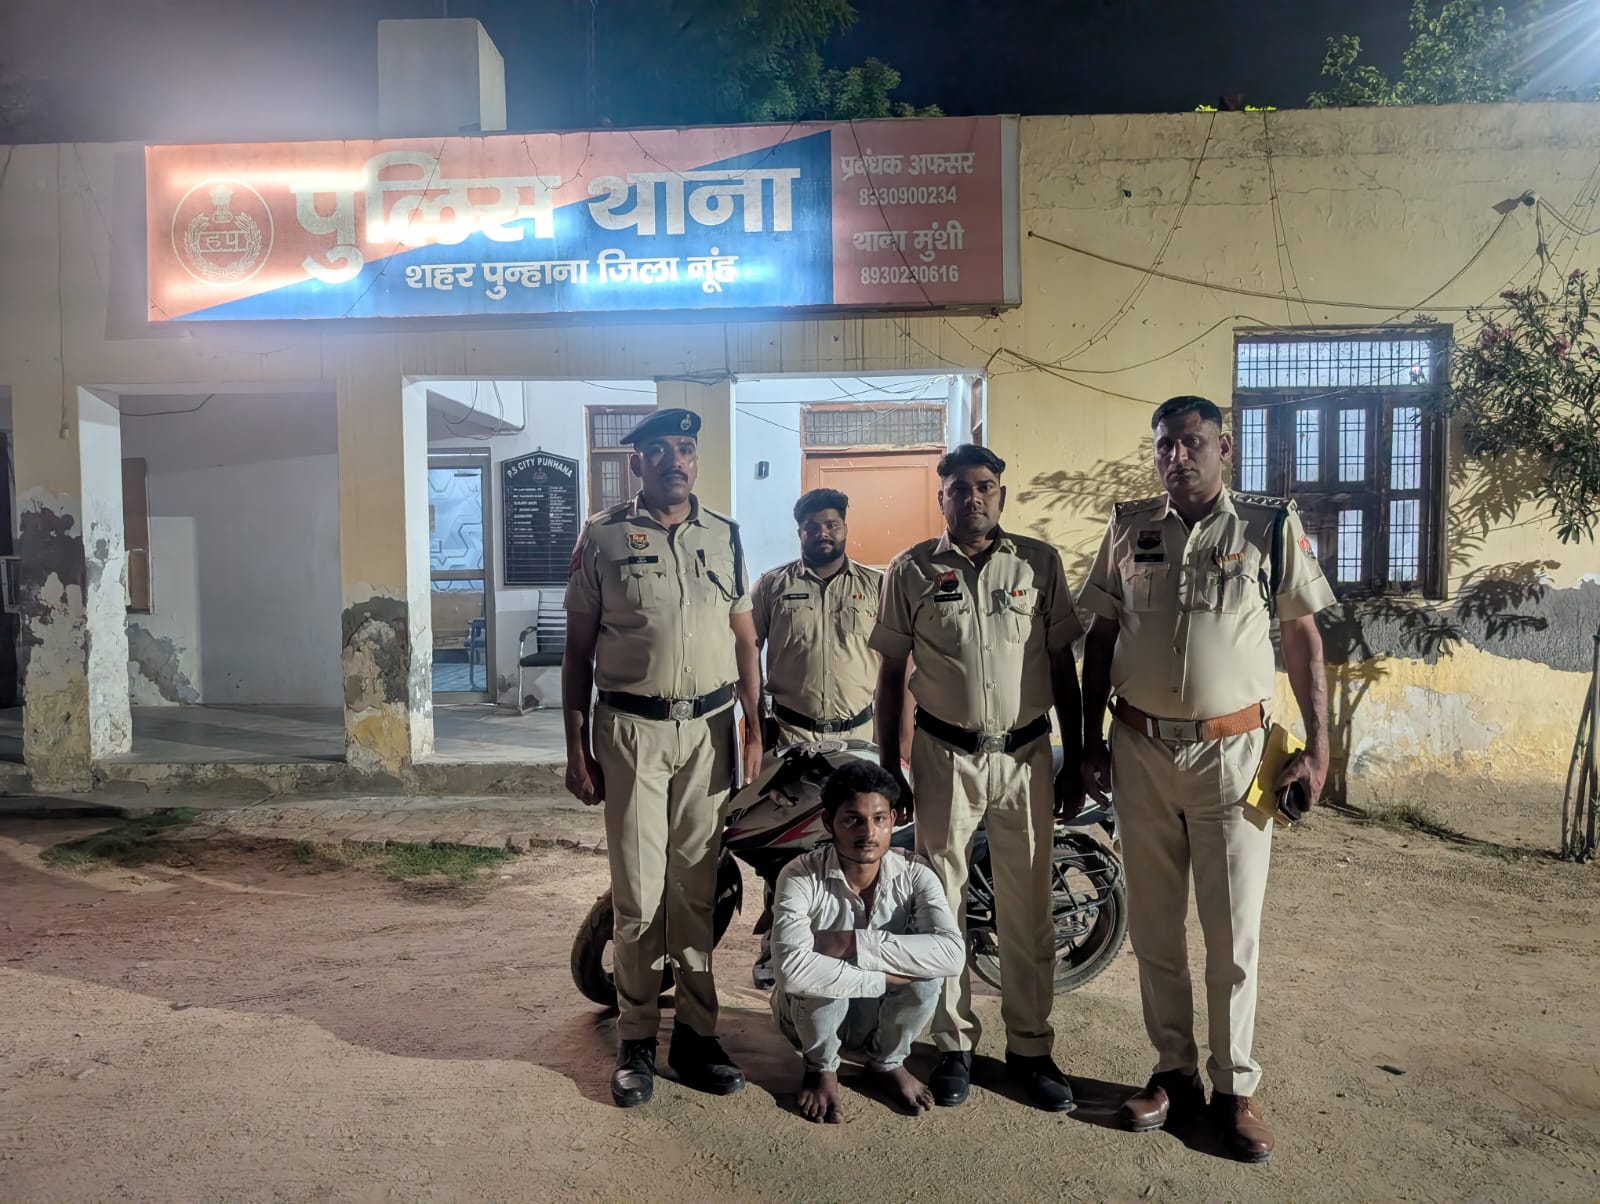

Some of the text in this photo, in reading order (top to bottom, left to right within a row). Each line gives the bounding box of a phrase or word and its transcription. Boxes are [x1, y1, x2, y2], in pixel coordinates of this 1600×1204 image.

[840, 147, 975, 181] प्रबंधक अफसर
[289, 150, 800, 284] पुलिस थाना
[853, 219, 965, 262] थाना मुंशी
[405, 246, 739, 300] शहर पुन्हाना जिला नूंह
[860, 265, 959, 285] 8930230616
[518, 457, 535, 470] CITY
[537, 457, 573, 478] PUNHANA
